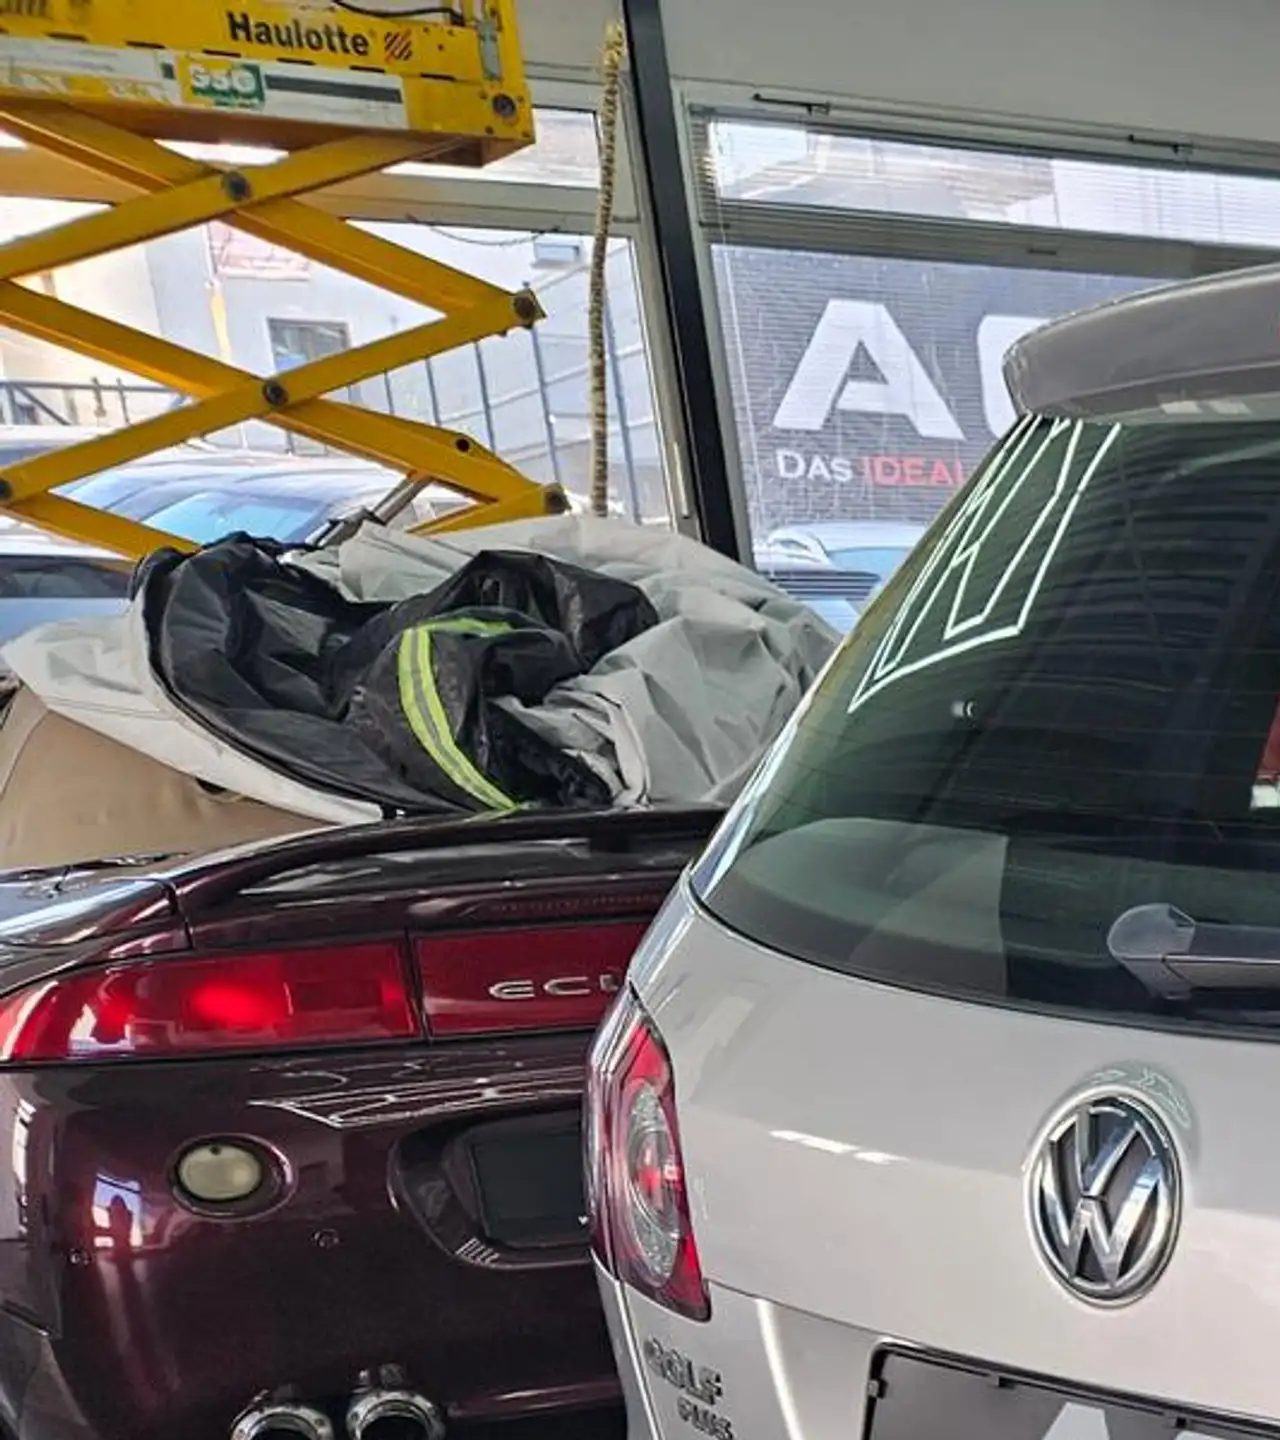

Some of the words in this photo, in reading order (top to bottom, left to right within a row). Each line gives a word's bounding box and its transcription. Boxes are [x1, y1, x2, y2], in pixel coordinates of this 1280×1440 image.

[226, 11, 371, 56] Haulotte
[776, 450, 854, 482] DAS
[1032, 1093, 1175, 1298] VW
